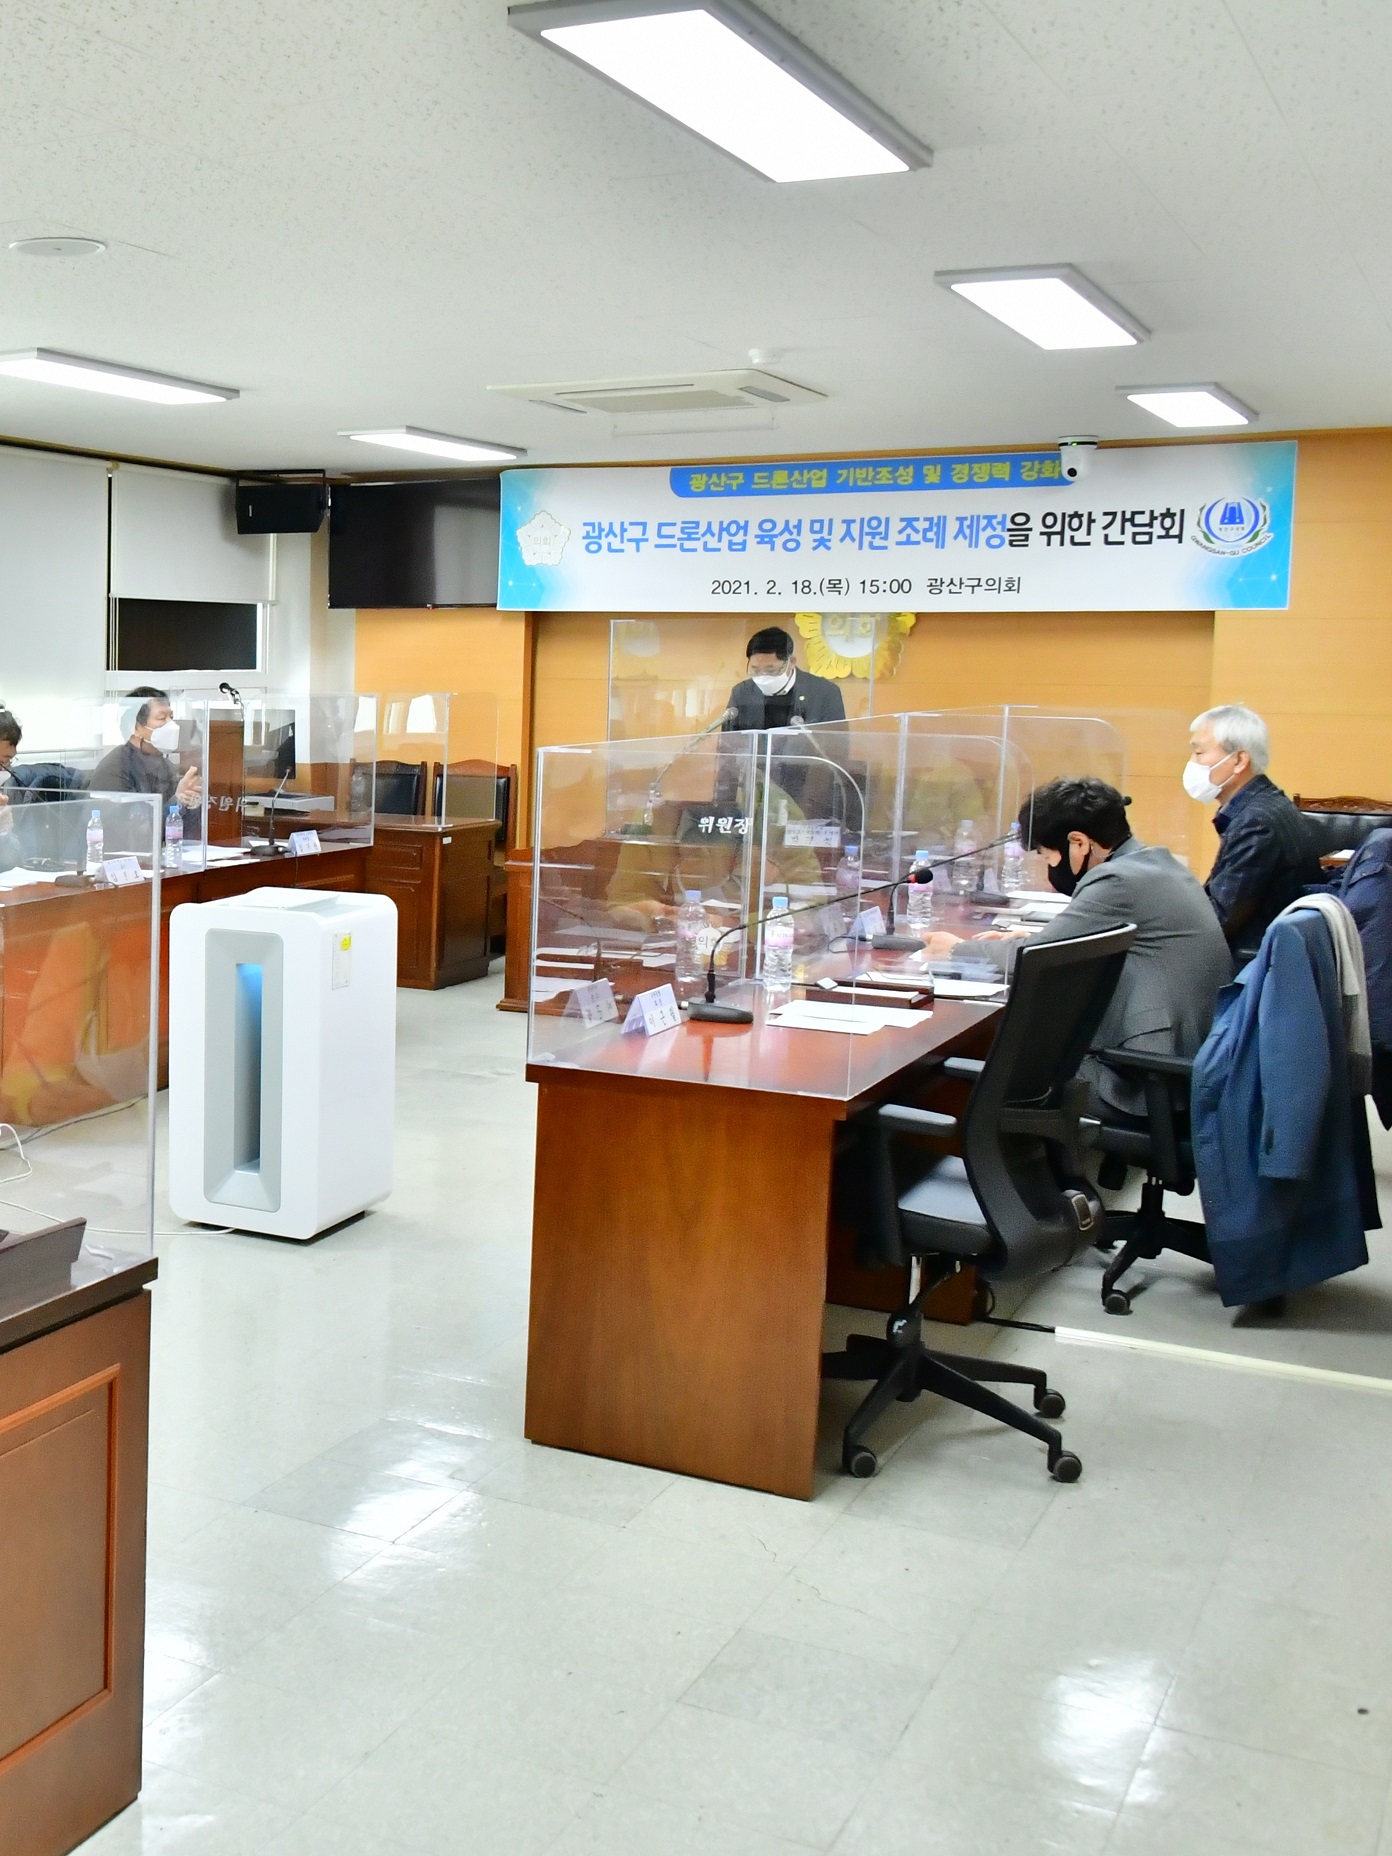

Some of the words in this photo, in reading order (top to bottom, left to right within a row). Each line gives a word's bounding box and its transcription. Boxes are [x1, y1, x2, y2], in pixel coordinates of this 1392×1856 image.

[689, 471, 745, 492] 광산구
[751, 468, 828, 490] 드론산업
[837, 465, 914, 488] 기반조성
[923, 463, 942, 484] 및
[951, 461, 1011, 483] 경쟁력
[1020, 459, 1061, 481] 강화
[581, 519, 649, 555] 광산구
[654, 518, 750, 553] 드론산업
[754, 516, 802, 552] 육성
[808, 517, 834, 551] 및
[839, 515, 890, 551] 지원
[895, 514, 948, 551] 조례
[953, 511, 1034, 550] 제정을
[1039, 510, 1096, 548] 위한
[1101, 507, 1186, 546] 간담회
[1191, 535, 1239, 556] GWANGSAN-GU
[1241, 533, 1272, 554] COUNCIL
[710, 579, 758, 596] 2021.
[766, 579, 782, 596] 2.
[791, 577, 851, 597] 18.(목)
[858, 577, 913, 595] 15:00
[926, 575, 1022, 596] 광산구의회
[697, 815, 753, 835] 위원장
